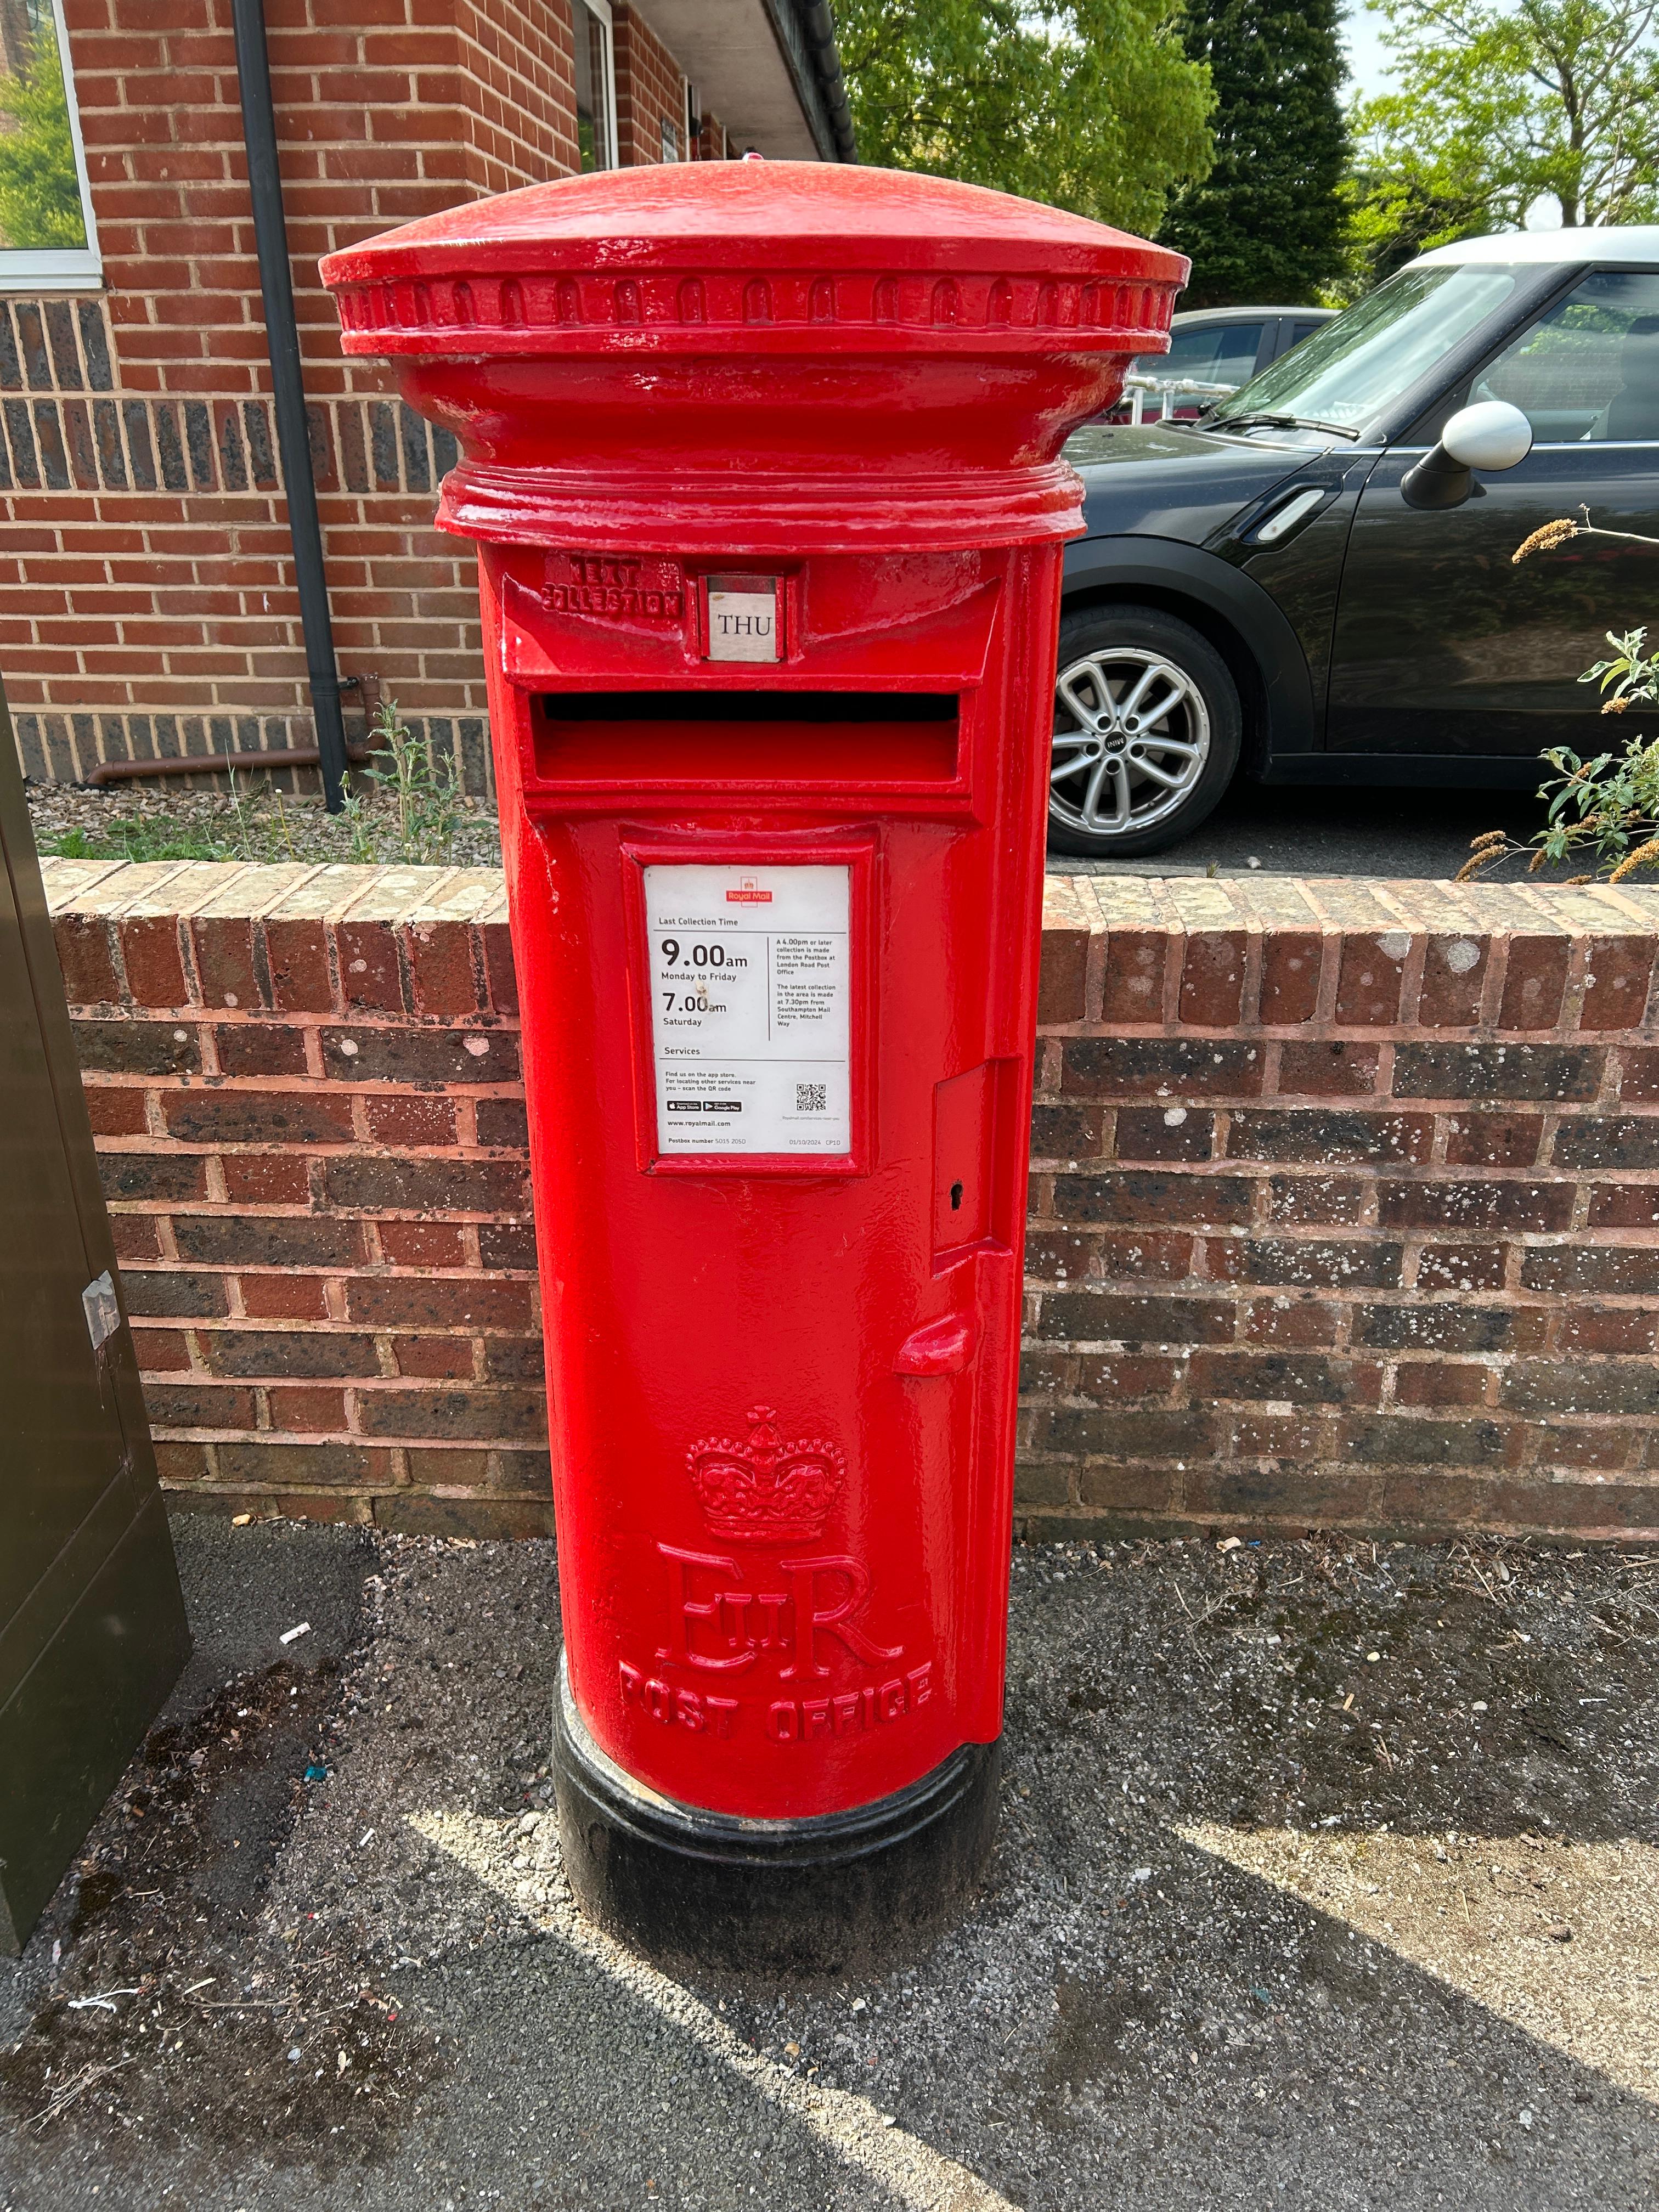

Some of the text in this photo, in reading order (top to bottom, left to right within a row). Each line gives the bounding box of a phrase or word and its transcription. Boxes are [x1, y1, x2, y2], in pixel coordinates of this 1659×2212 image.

[718, 614, 772, 636] THU
[1107, 738, 1124, 748] MINI
[729, 892, 751, 901] Royal
[679, 917, 716, 926] Collection
[661, 972, 696, 981] Monday
[710, 973, 737, 982] Friday
[663, 1018, 702, 1027] Saturday
[664, 1047, 700, 1055] Services
[619, 1660, 932, 1743] POST OFFICE
